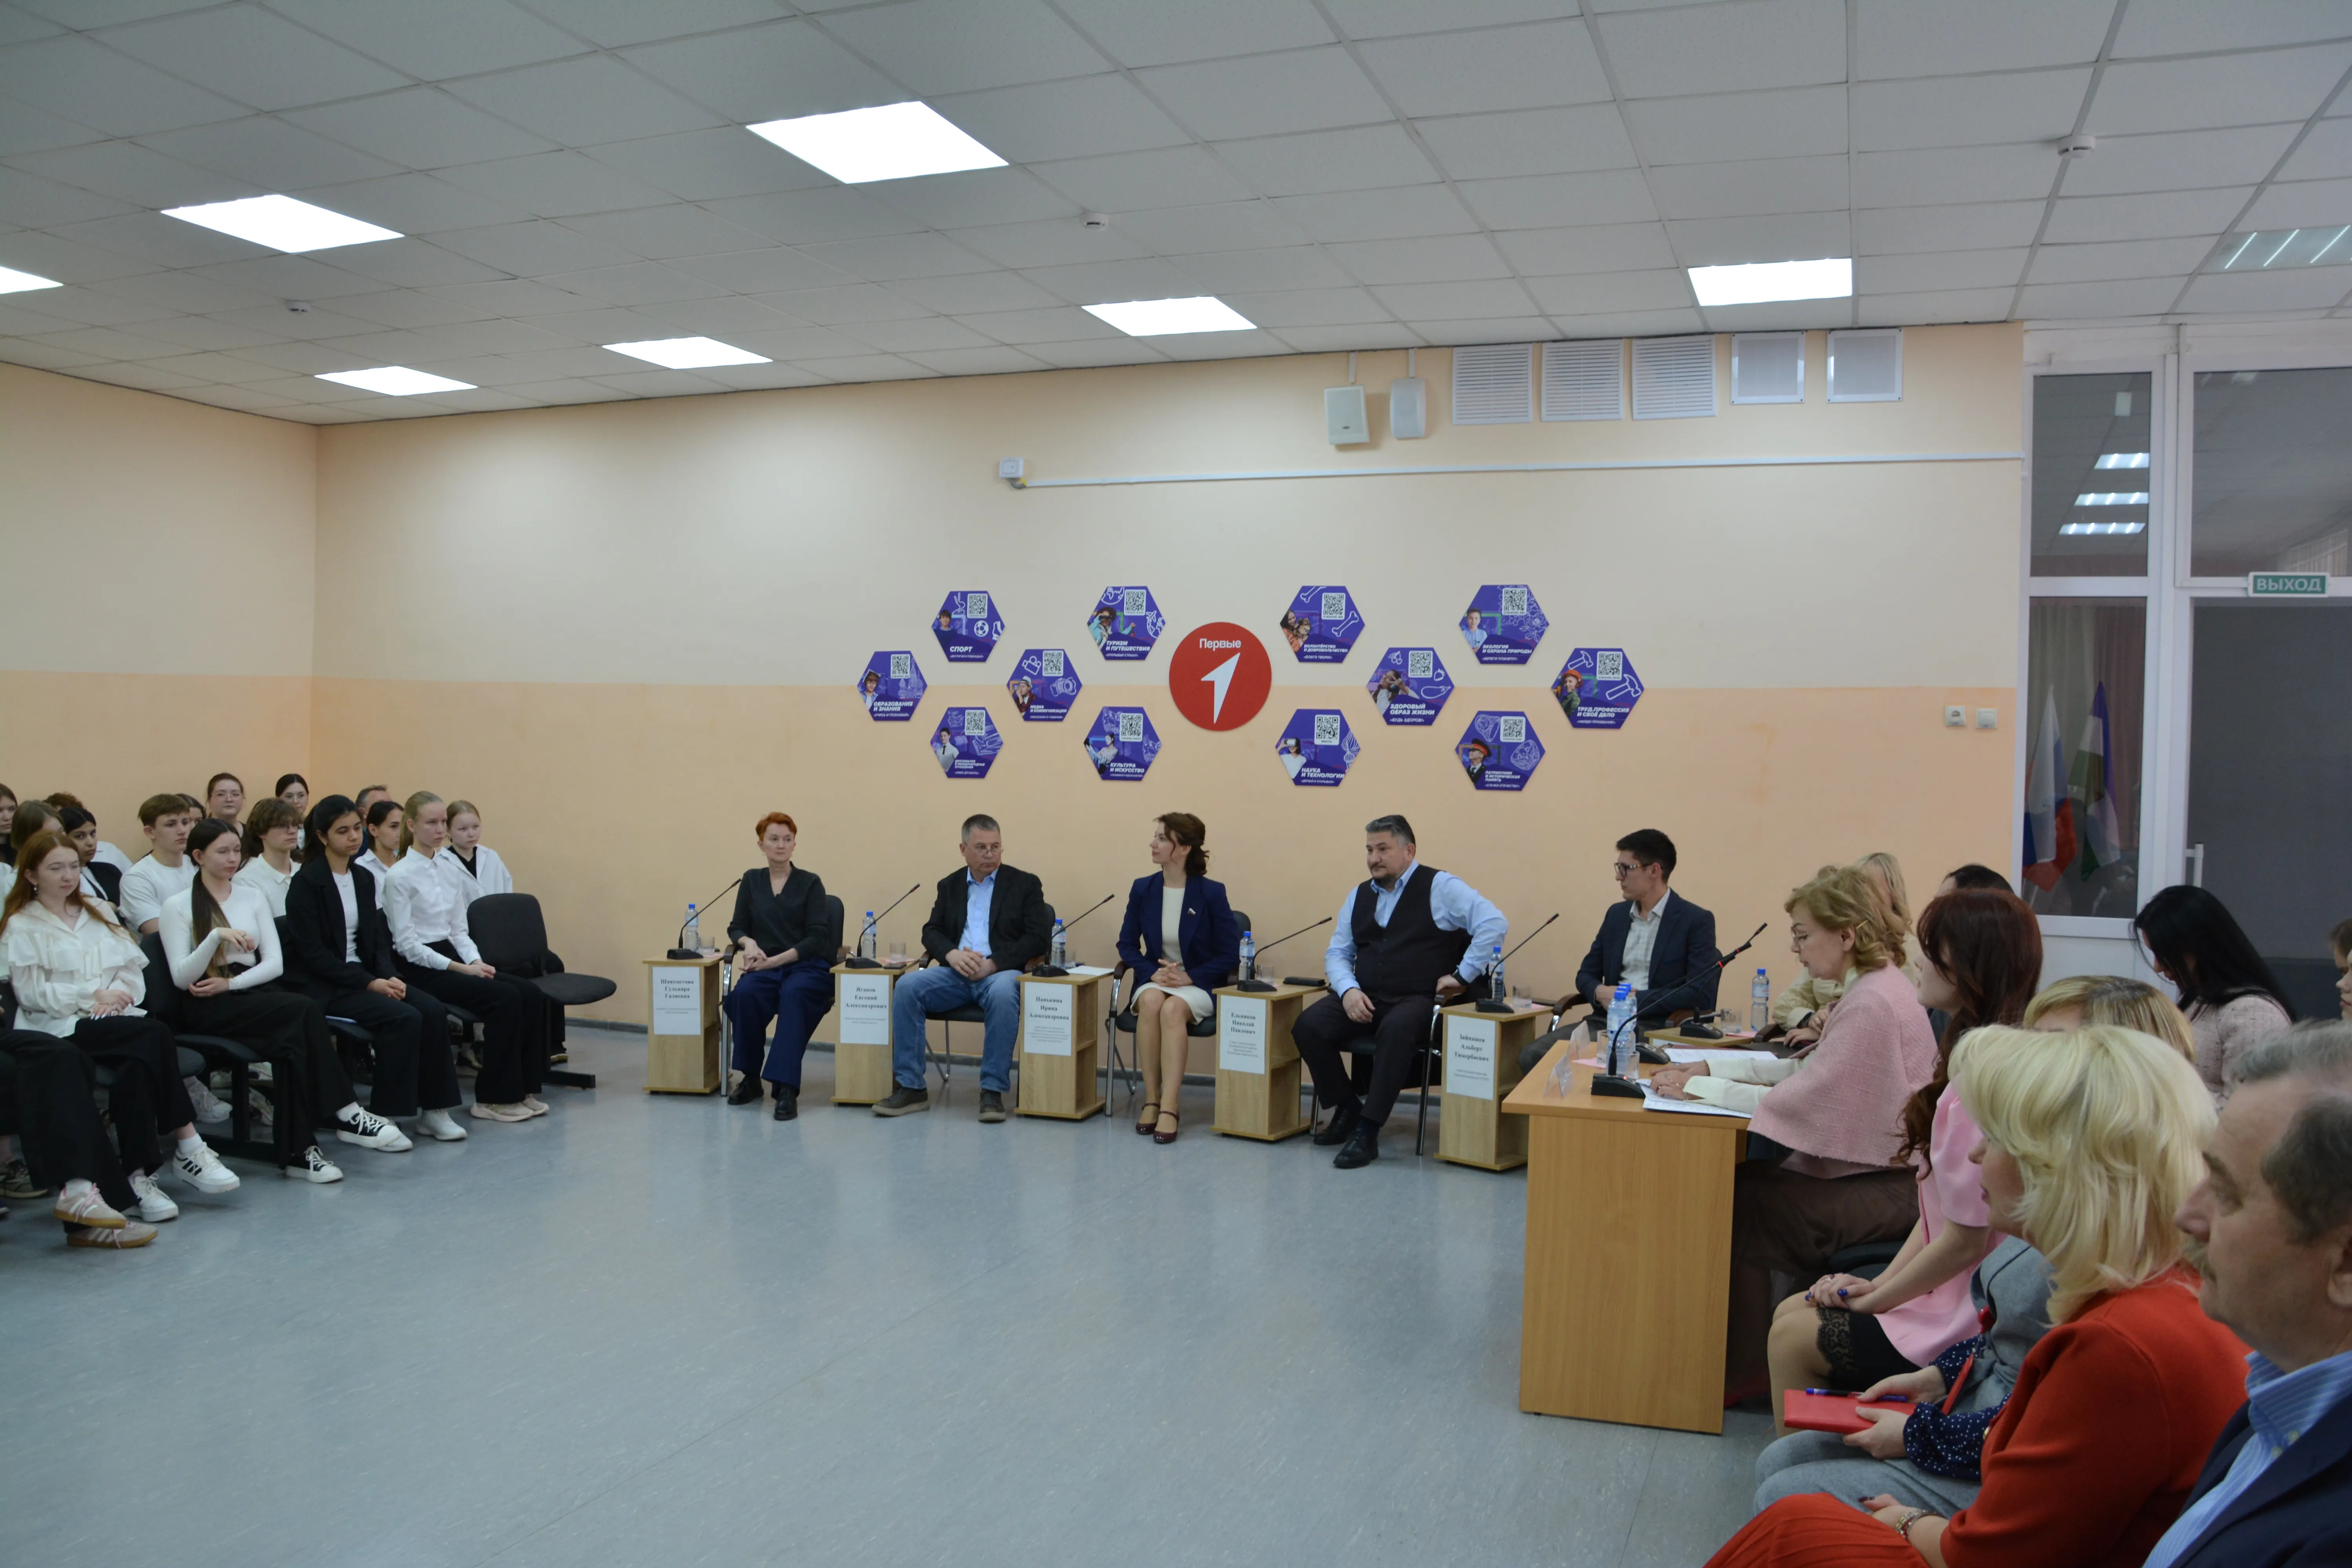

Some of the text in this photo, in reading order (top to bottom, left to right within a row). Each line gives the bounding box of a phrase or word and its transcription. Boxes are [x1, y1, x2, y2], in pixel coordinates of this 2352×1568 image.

[2257, 578, 2321, 592] ВЫХОД
[1200, 638, 1241, 652] Первые
[1231, 1027, 1256, 1035] Павлович
[1461, 1044, 1483, 1053] Альберт
[1454, 1051, 1489, 1062] Тимербаевич
